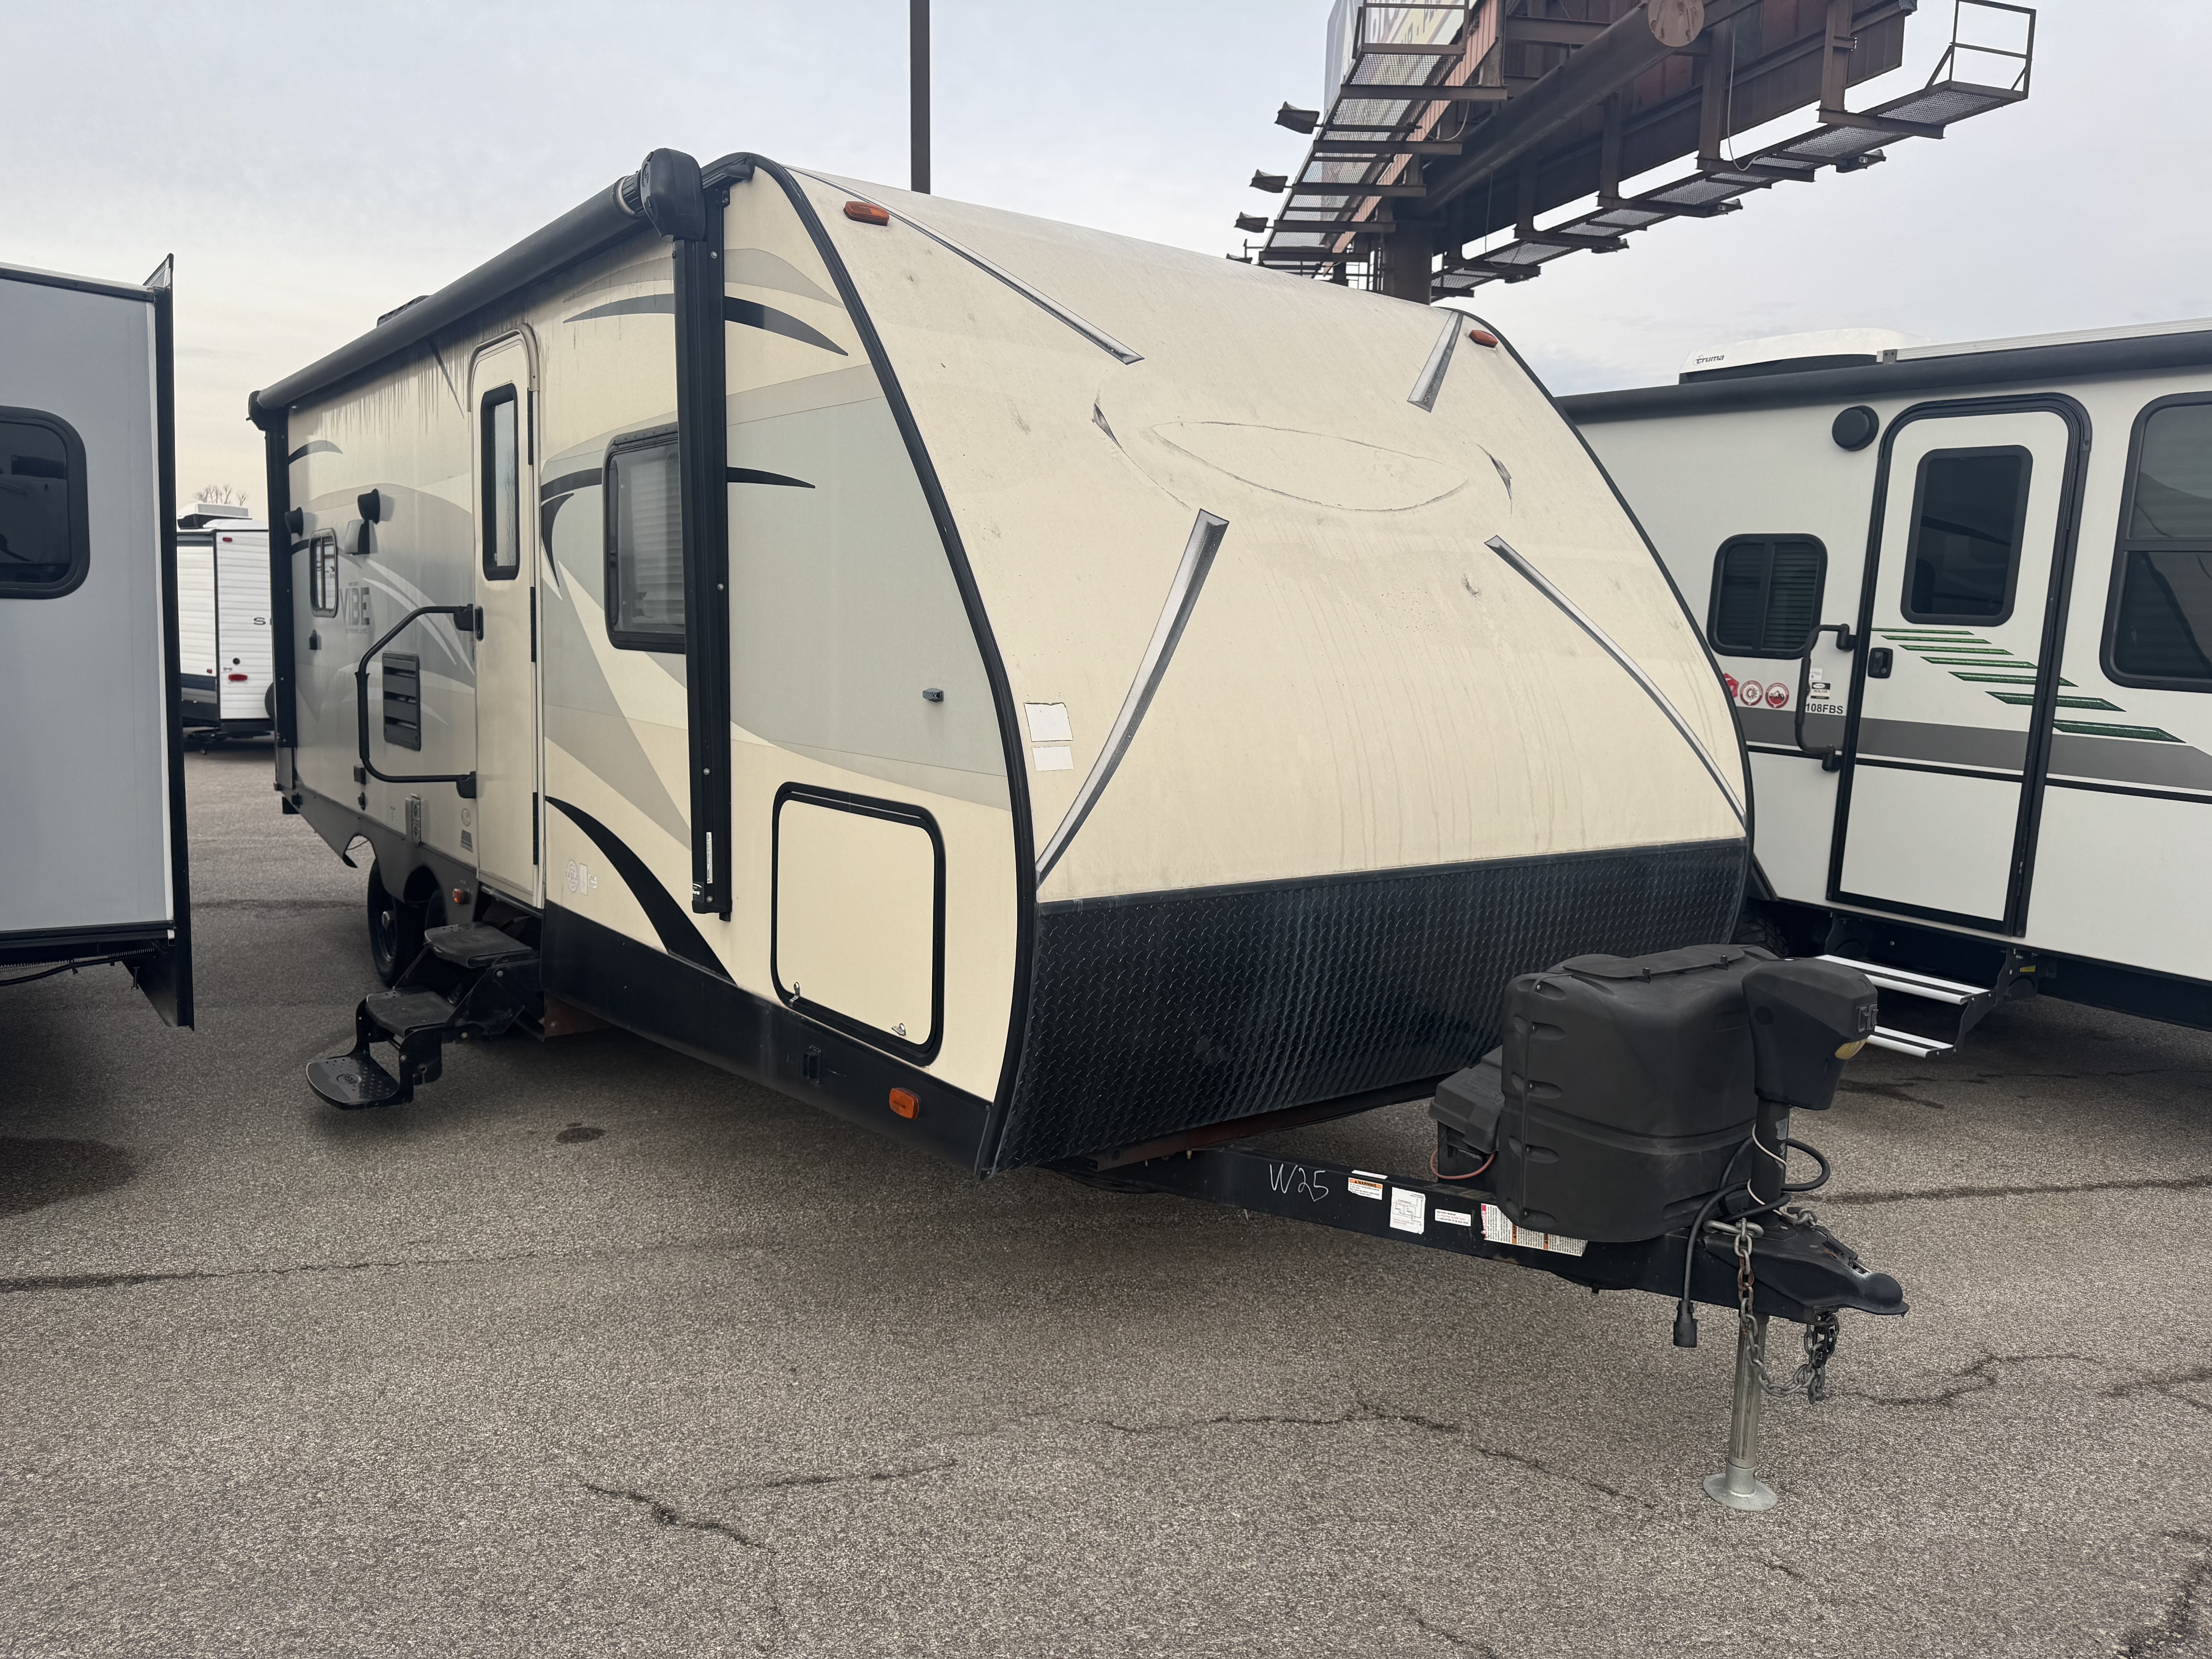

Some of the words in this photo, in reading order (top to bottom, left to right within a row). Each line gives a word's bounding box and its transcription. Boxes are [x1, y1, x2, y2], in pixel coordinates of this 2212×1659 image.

[1696, 355, 1724, 364] truma
[339, 587, 370, 625] VIBE
[566, 870, 579, 884] USA
[1269, 1163, 1329, 1202] W25
